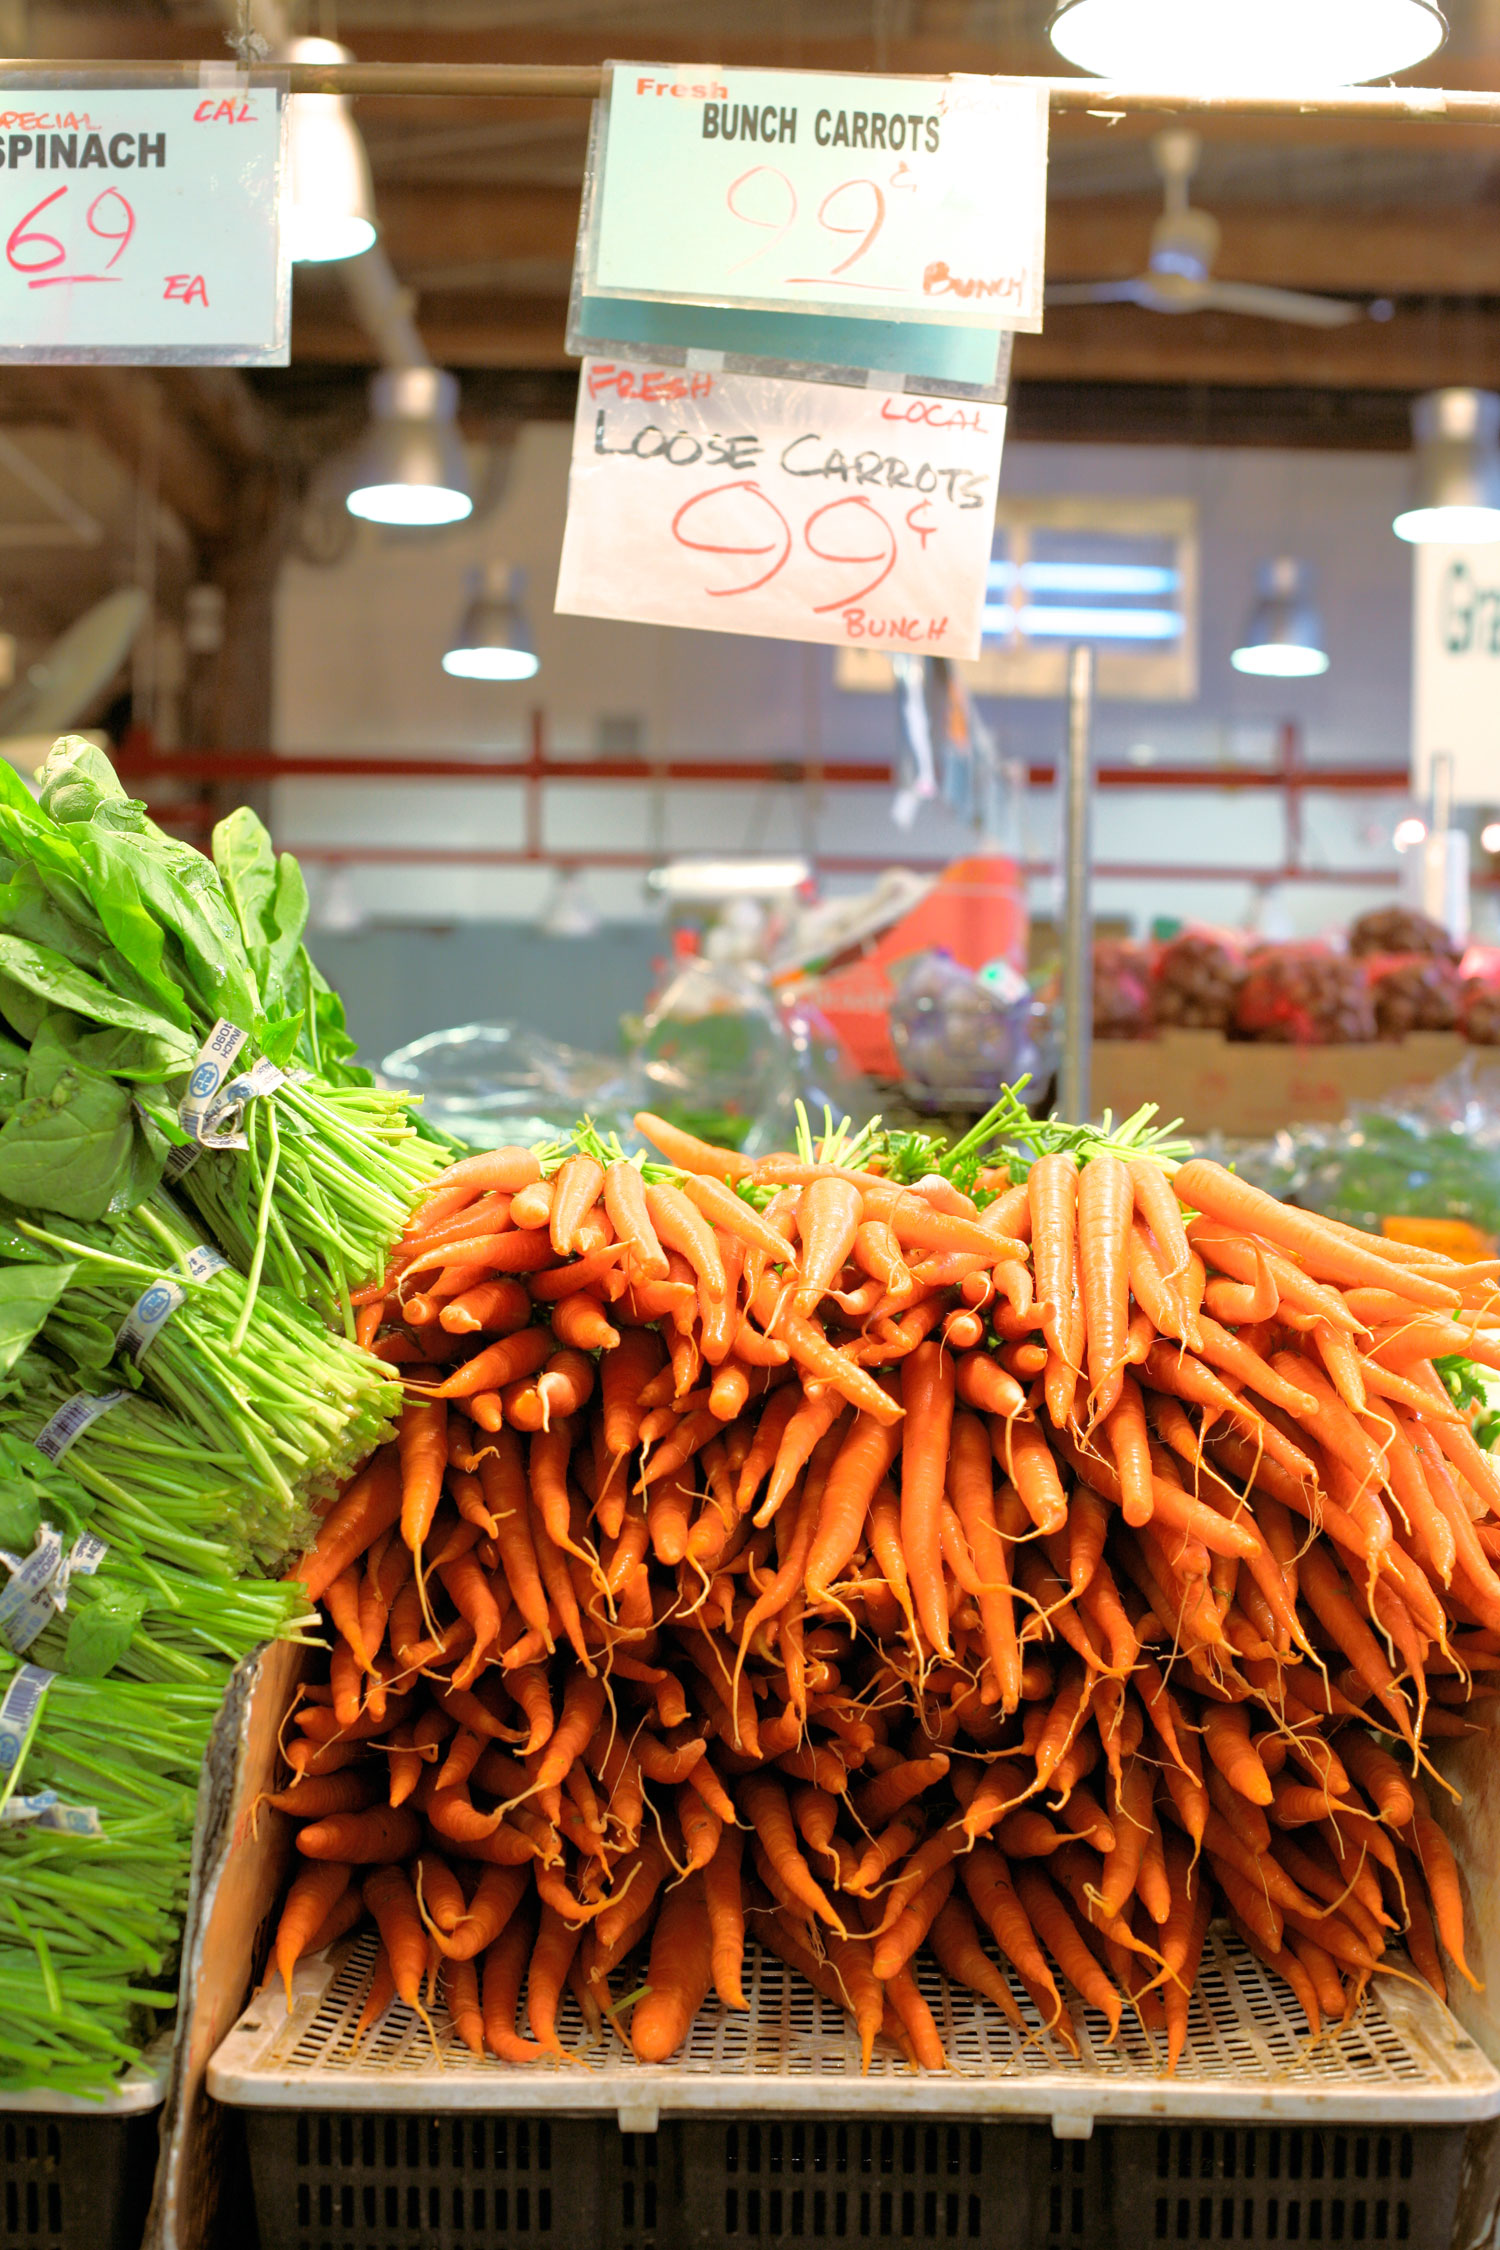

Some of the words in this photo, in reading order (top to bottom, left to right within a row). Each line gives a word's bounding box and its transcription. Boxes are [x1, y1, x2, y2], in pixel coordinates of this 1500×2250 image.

[635, 77, 729, 100] Fresh
[0, 111, 103, 131] PECIAL
[193, 97, 258, 125] CAL
[702, 102, 798, 144] BUNCH
[813, 108, 941, 153] CARROTS
[0, 132, 167, 169] PINACH
[6, 184, 136, 273] 69
[163, 274, 209, 307] EA
[588, 364, 717, 402] FRESH
[881, 397, 989, 434] LOCAL
[594, 409, 764, 469] LOOSE
[780, 433, 991, 510] CARROTS
[842, 608, 948, 642] BUNCH
